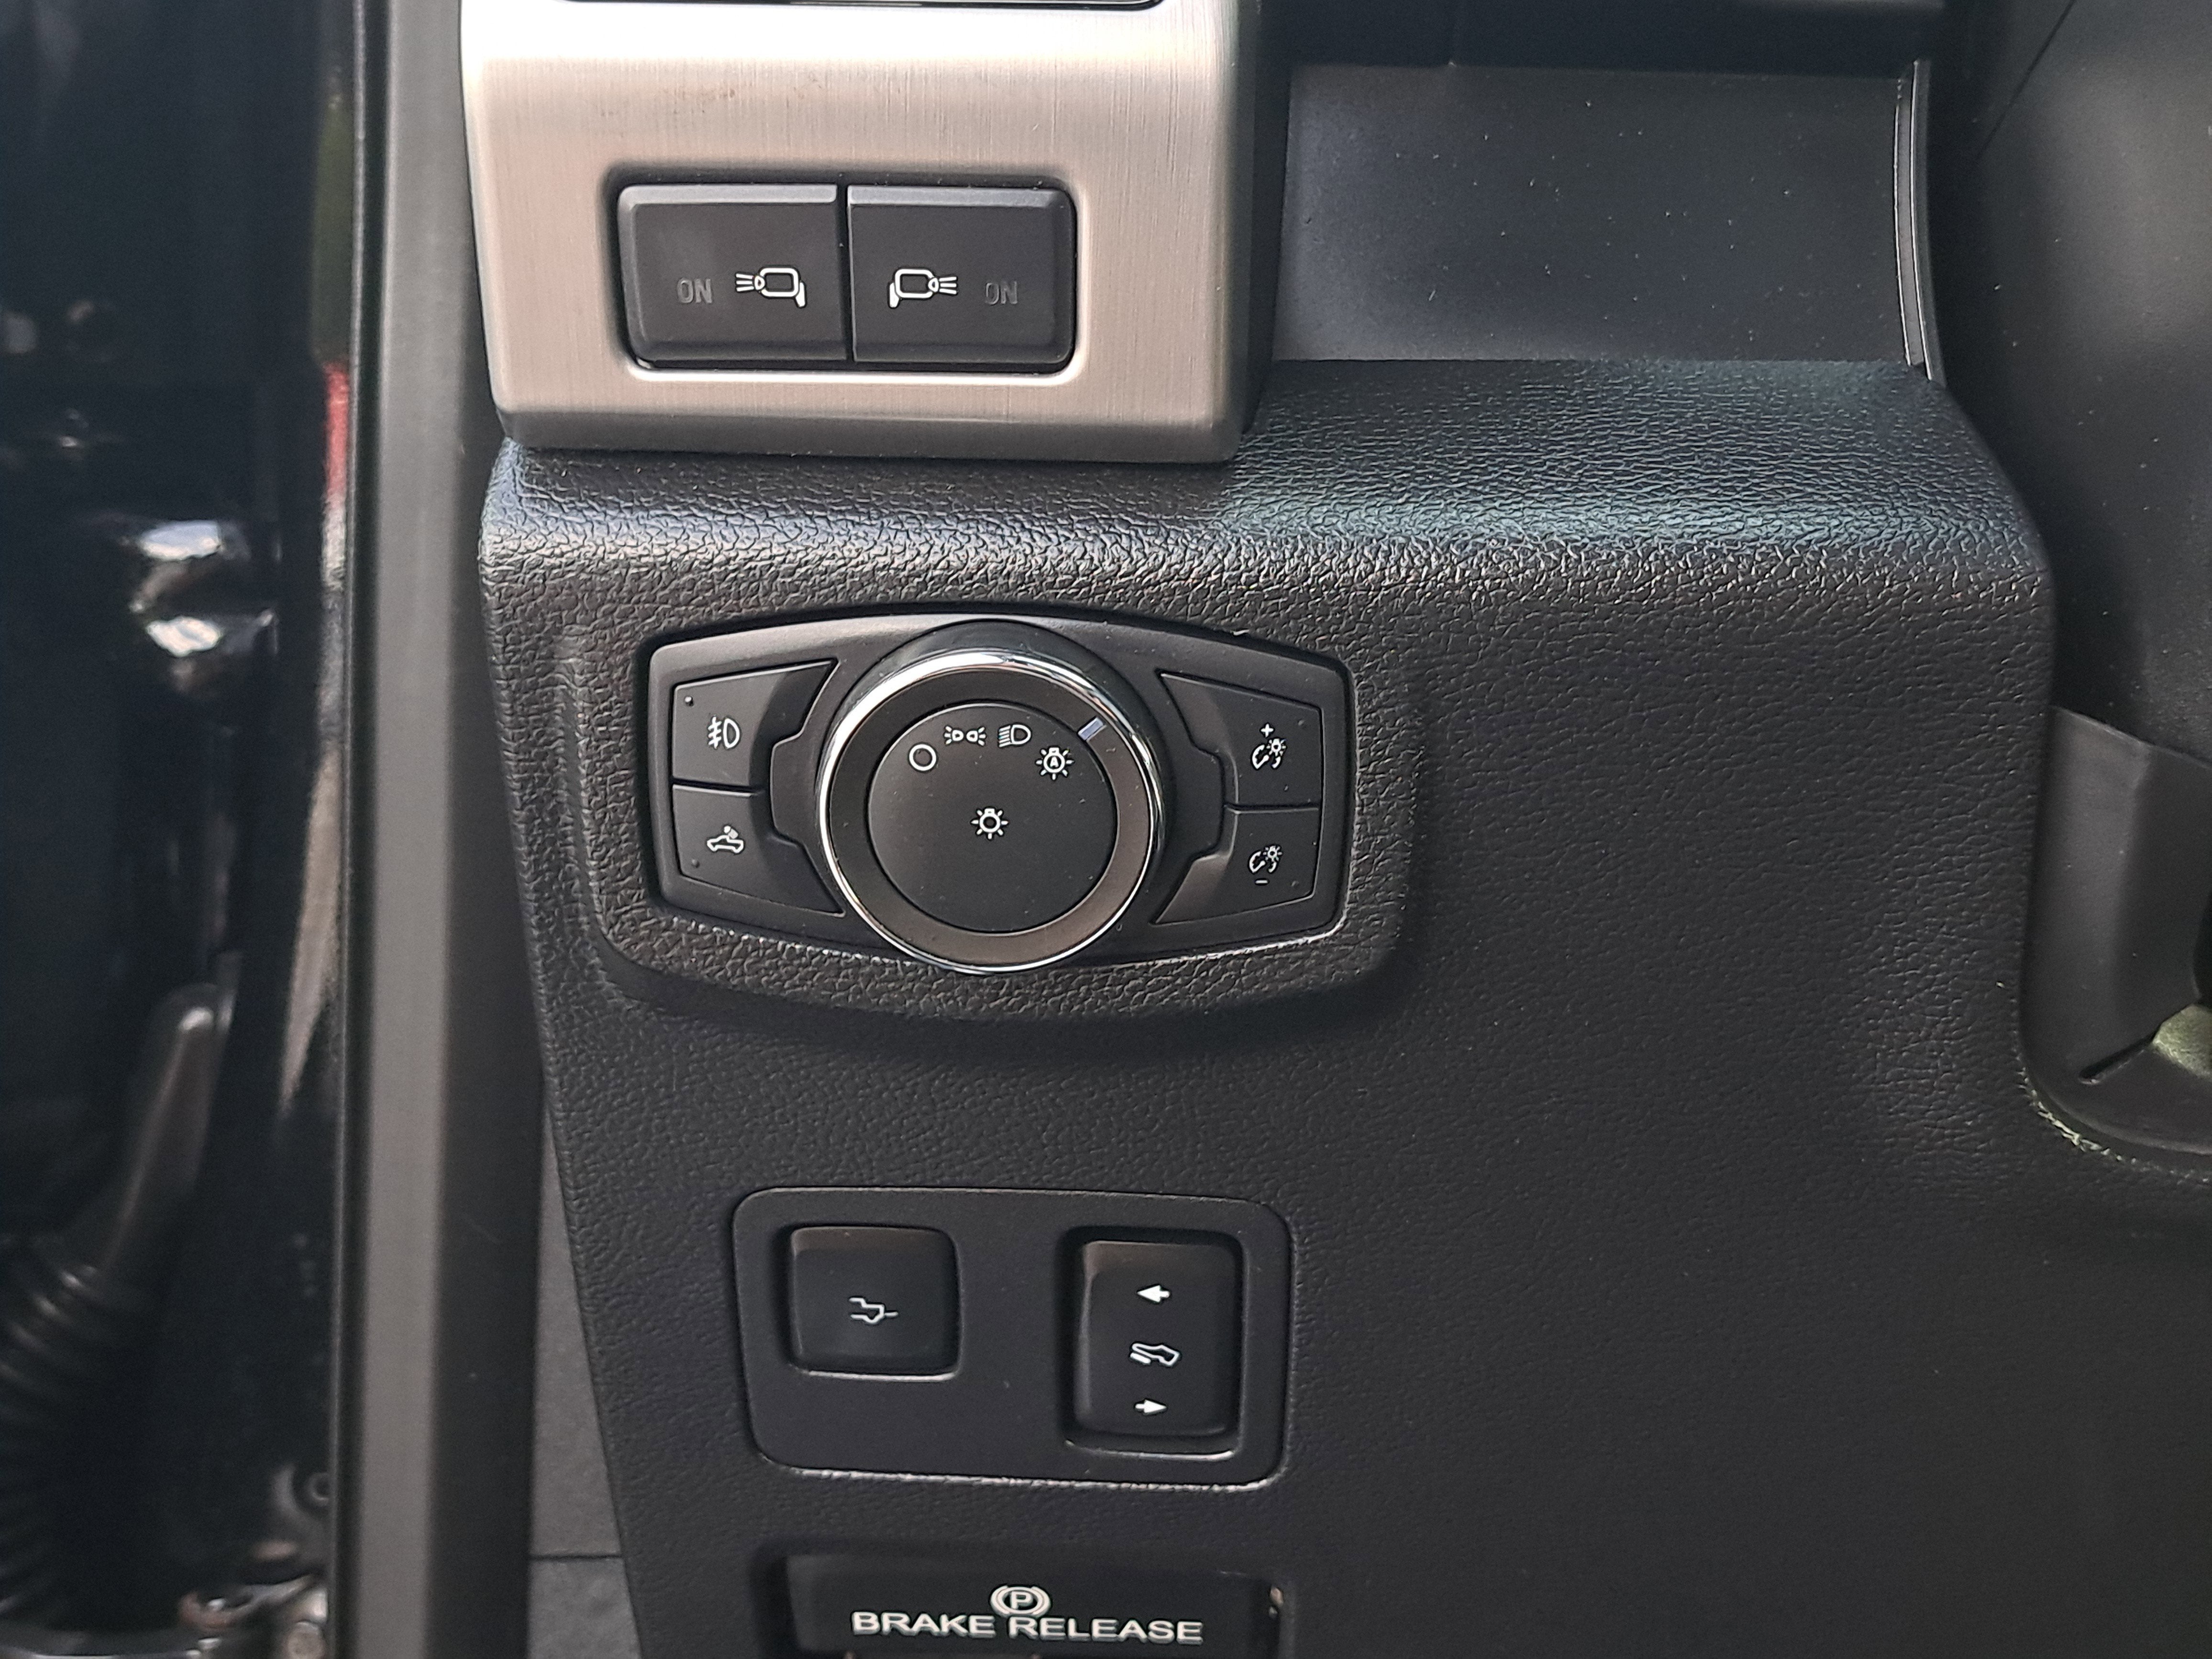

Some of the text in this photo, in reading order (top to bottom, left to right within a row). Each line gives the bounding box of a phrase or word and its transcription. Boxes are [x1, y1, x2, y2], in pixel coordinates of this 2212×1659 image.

[676, 277, 712, 304] ON
[984, 280, 1018, 305] ON
[852, 1612, 1203, 1644] BRAKE RELEASE
